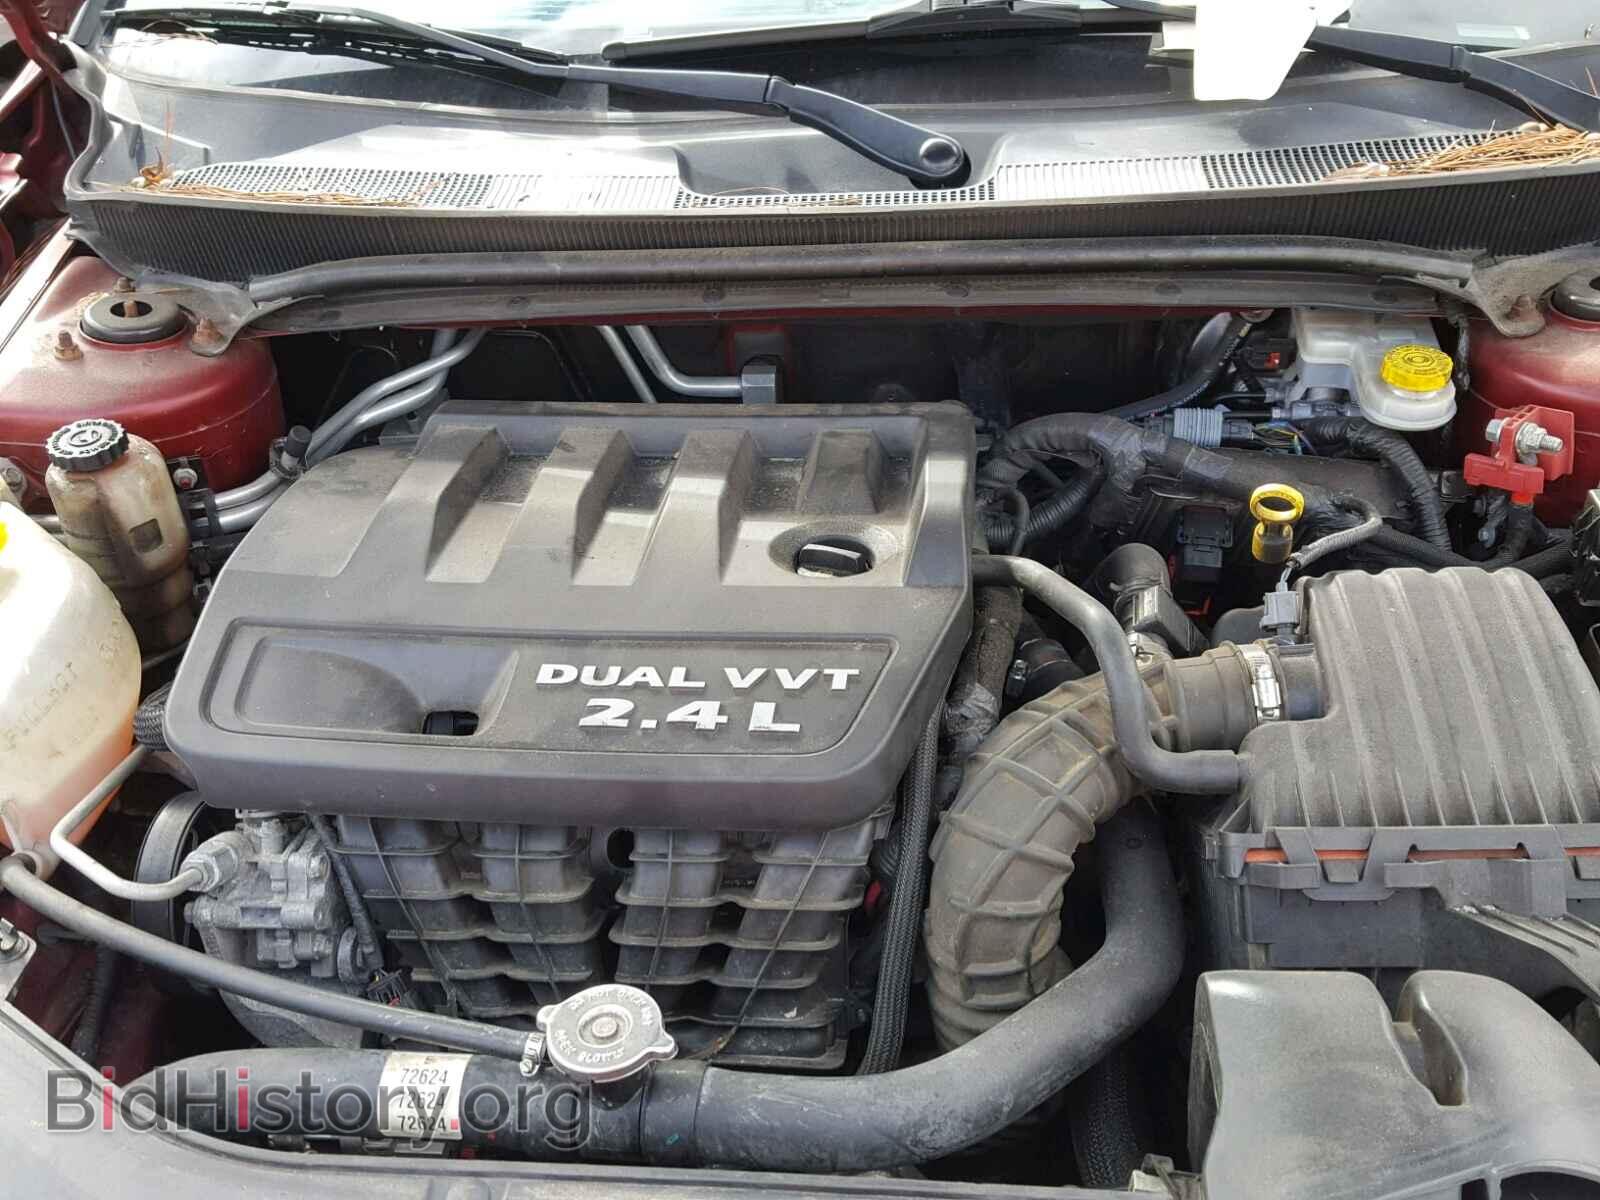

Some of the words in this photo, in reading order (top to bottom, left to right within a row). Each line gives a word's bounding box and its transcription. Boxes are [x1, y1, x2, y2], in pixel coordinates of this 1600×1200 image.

[535, 663, 706, 690] DUAL
[723, 667, 860, 690] VVT
[400, 1067, 448, 1085] 72624
[398, 1091, 445, 1109] 72624
[397, 1115, 446, 1131] 72624
